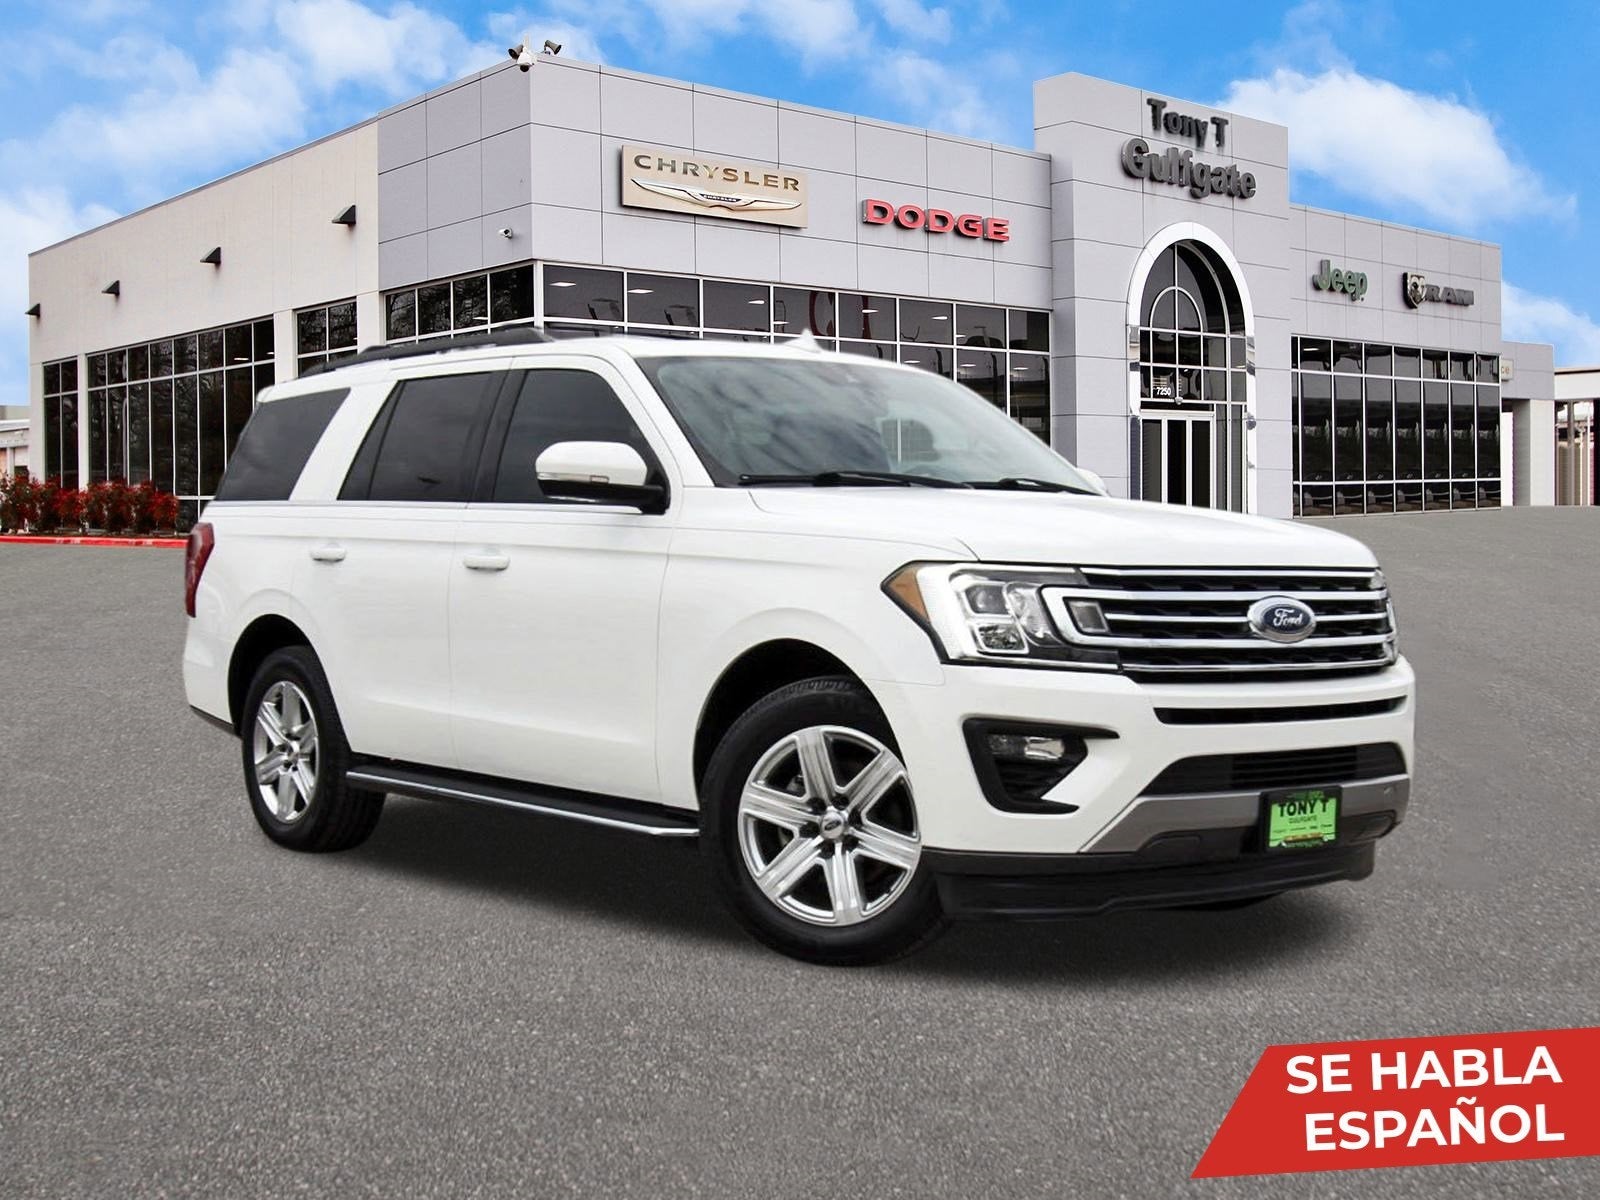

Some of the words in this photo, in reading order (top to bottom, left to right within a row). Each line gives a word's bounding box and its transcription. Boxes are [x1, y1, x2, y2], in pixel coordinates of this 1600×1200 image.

[1147, 98, 1208, 148] Tony
[1211, 117, 1229, 147] T
[634, 154, 800, 191] CHRYSLER
[1121, 138, 1256, 199] Gulfgate
[862, 198, 1011, 242] DODGE
[1312, 259, 1367, 301] Jeep
[1424, 284, 1474, 306] RAM
[1156, 387, 1171, 396] 7250
[1273, 608, 1303, 627] Ford
[1278, 799, 1317, 817] TONY
